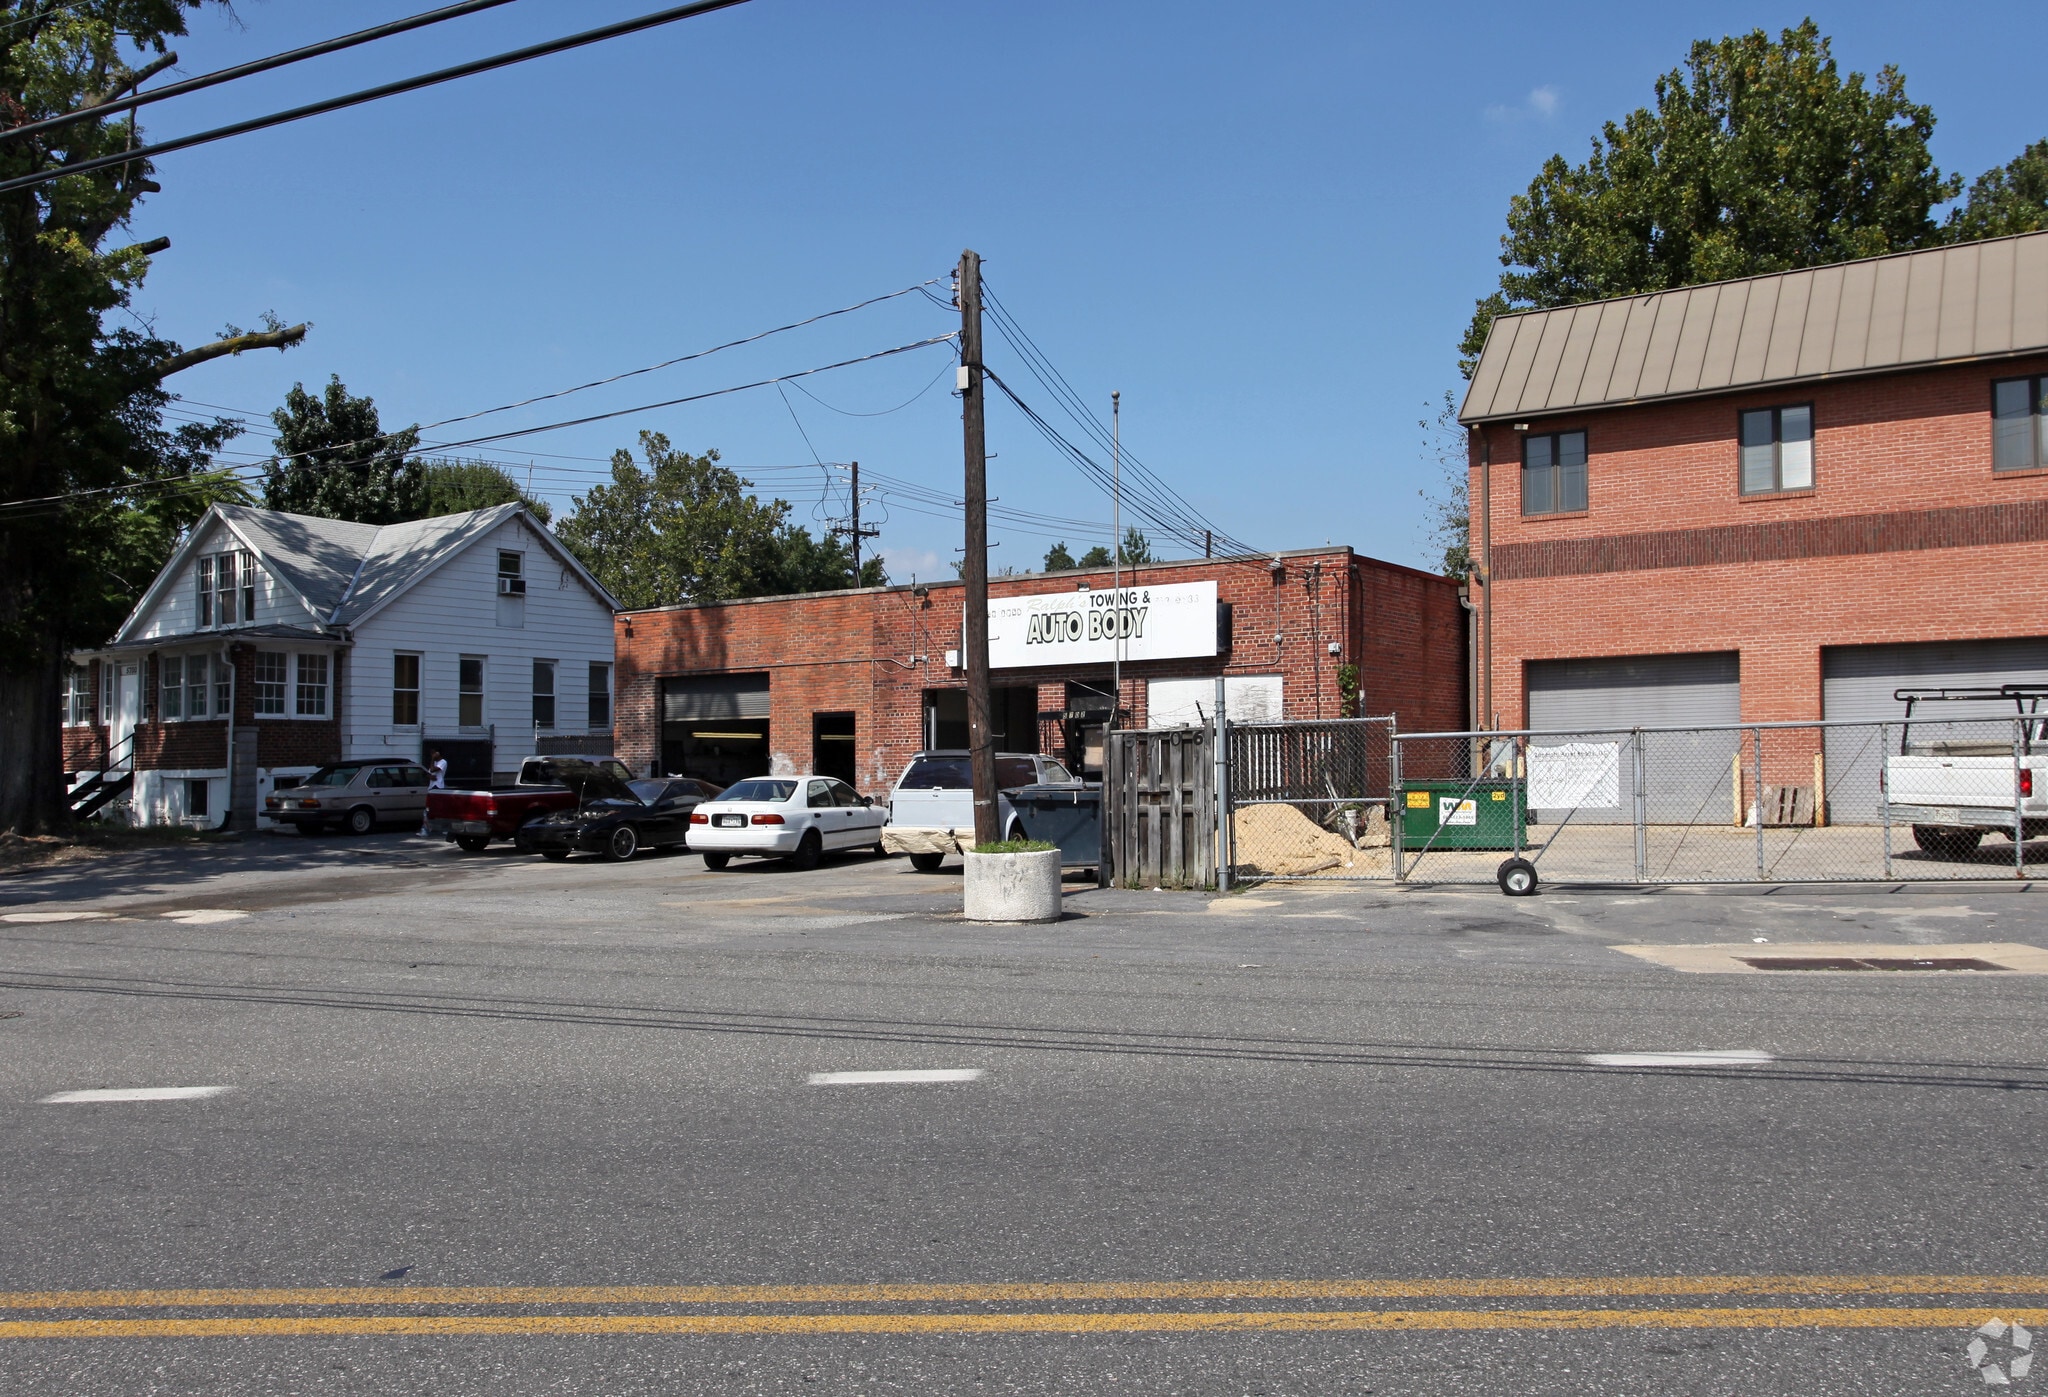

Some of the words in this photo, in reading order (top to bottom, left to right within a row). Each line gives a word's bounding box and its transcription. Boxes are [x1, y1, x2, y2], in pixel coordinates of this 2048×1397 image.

[1026, 595, 1088, 612] Ralph's
[1089, 591, 1137, 607] TOWNG
[1142, 590, 1151, 604] &
[1026, 611, 1083, 645] AUTO
[1088, 607, 1148, 641] BODY
